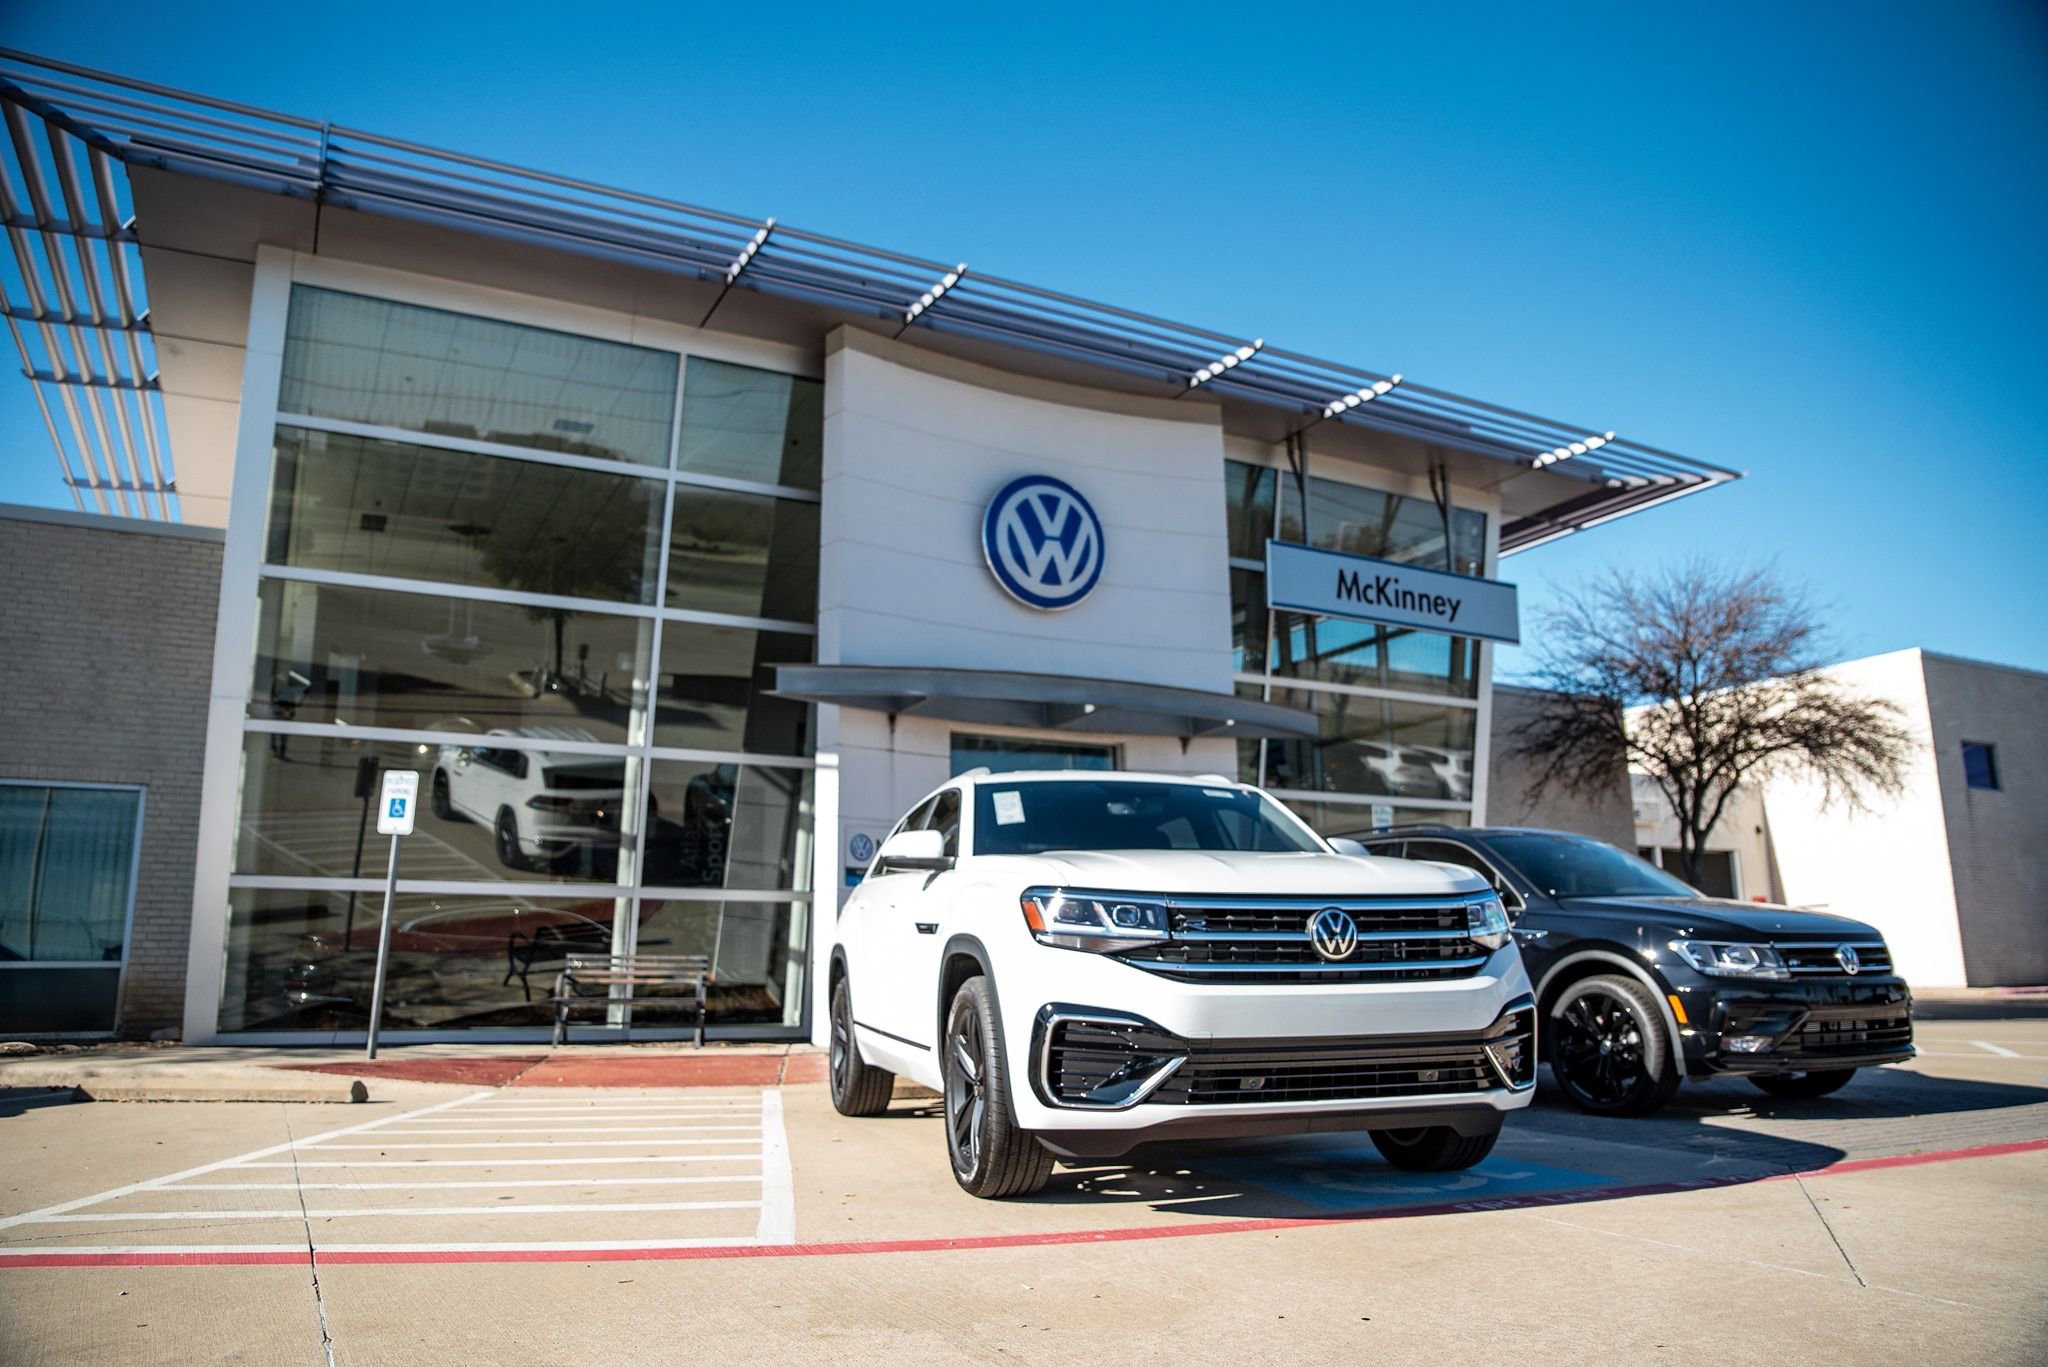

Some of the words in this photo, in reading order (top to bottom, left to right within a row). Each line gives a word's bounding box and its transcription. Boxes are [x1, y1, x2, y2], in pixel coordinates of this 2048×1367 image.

[995, 484, 1099, 599] VW
[1336, 569, 1461, 623] McKinney
[1312, 907, 1357, 959] VW
